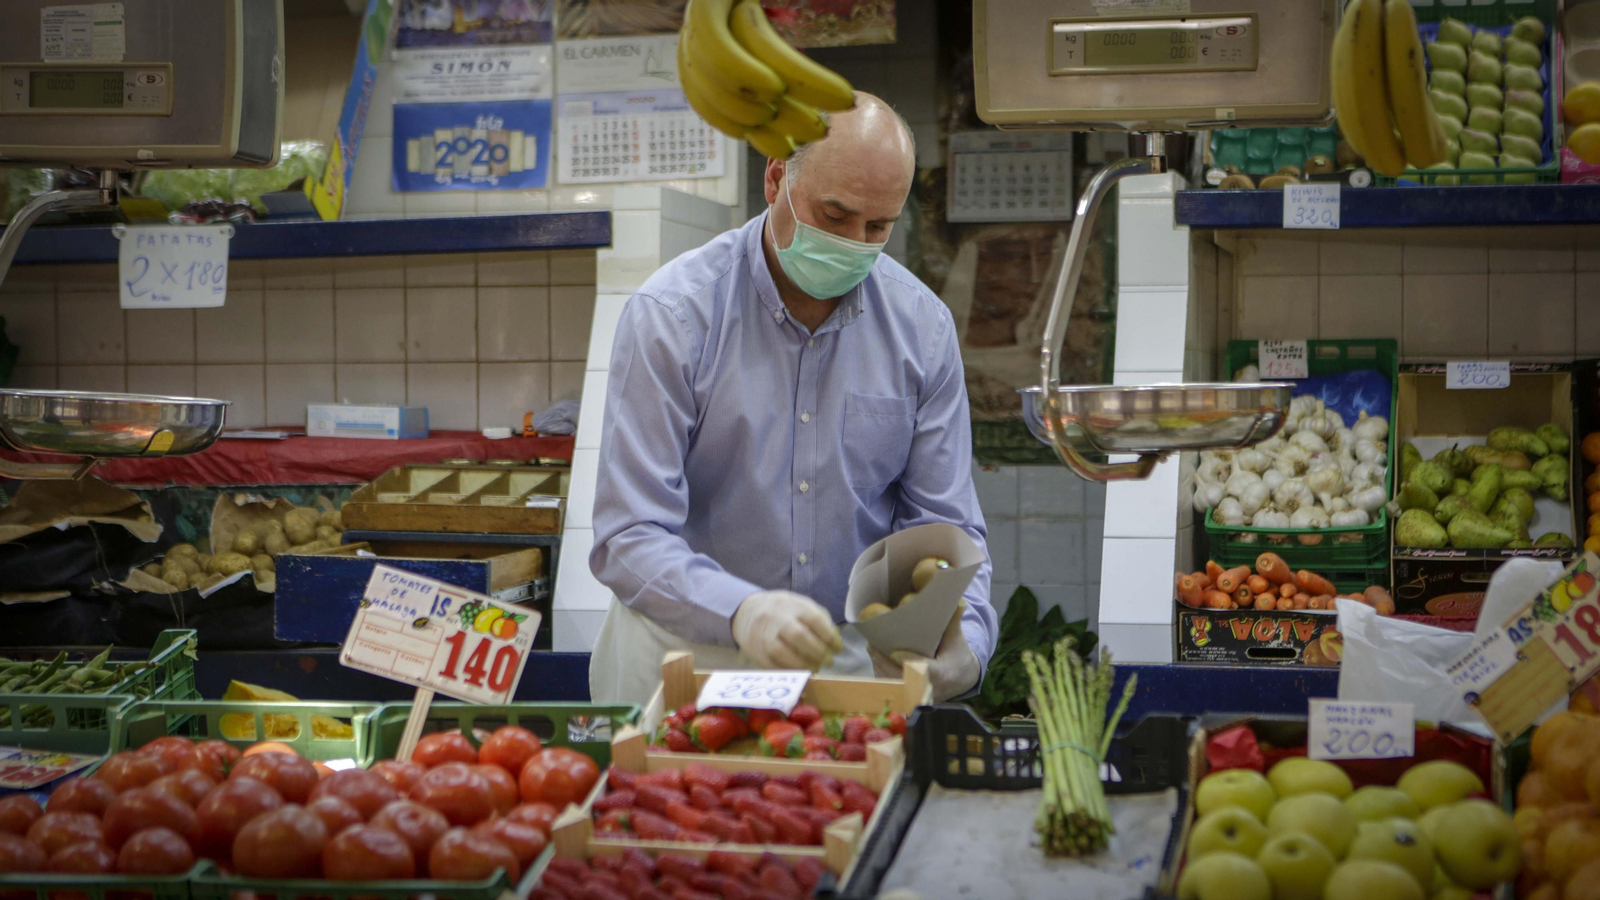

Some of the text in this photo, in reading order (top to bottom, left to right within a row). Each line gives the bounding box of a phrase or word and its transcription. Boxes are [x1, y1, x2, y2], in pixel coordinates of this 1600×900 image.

[1065, 34, 1077, 44] kg
[564, 44, 642, 60] EL CARMEN
[1067, 51, 1074, 59] T
[431, 58, 512, 75] SIMÓN
[434, 136, 509, 168] 2020
[136, 234, 212, 249] PATATAS
[125, 255, 155, 298] 2
[382, 571, 434, 594] TOMATES
[390, 587, 408, 599] DE
[1229, 617, 1318, 642] ALOA
[1553, 591, 1600, 667] 18
[438, 630, 520, 694] 140
